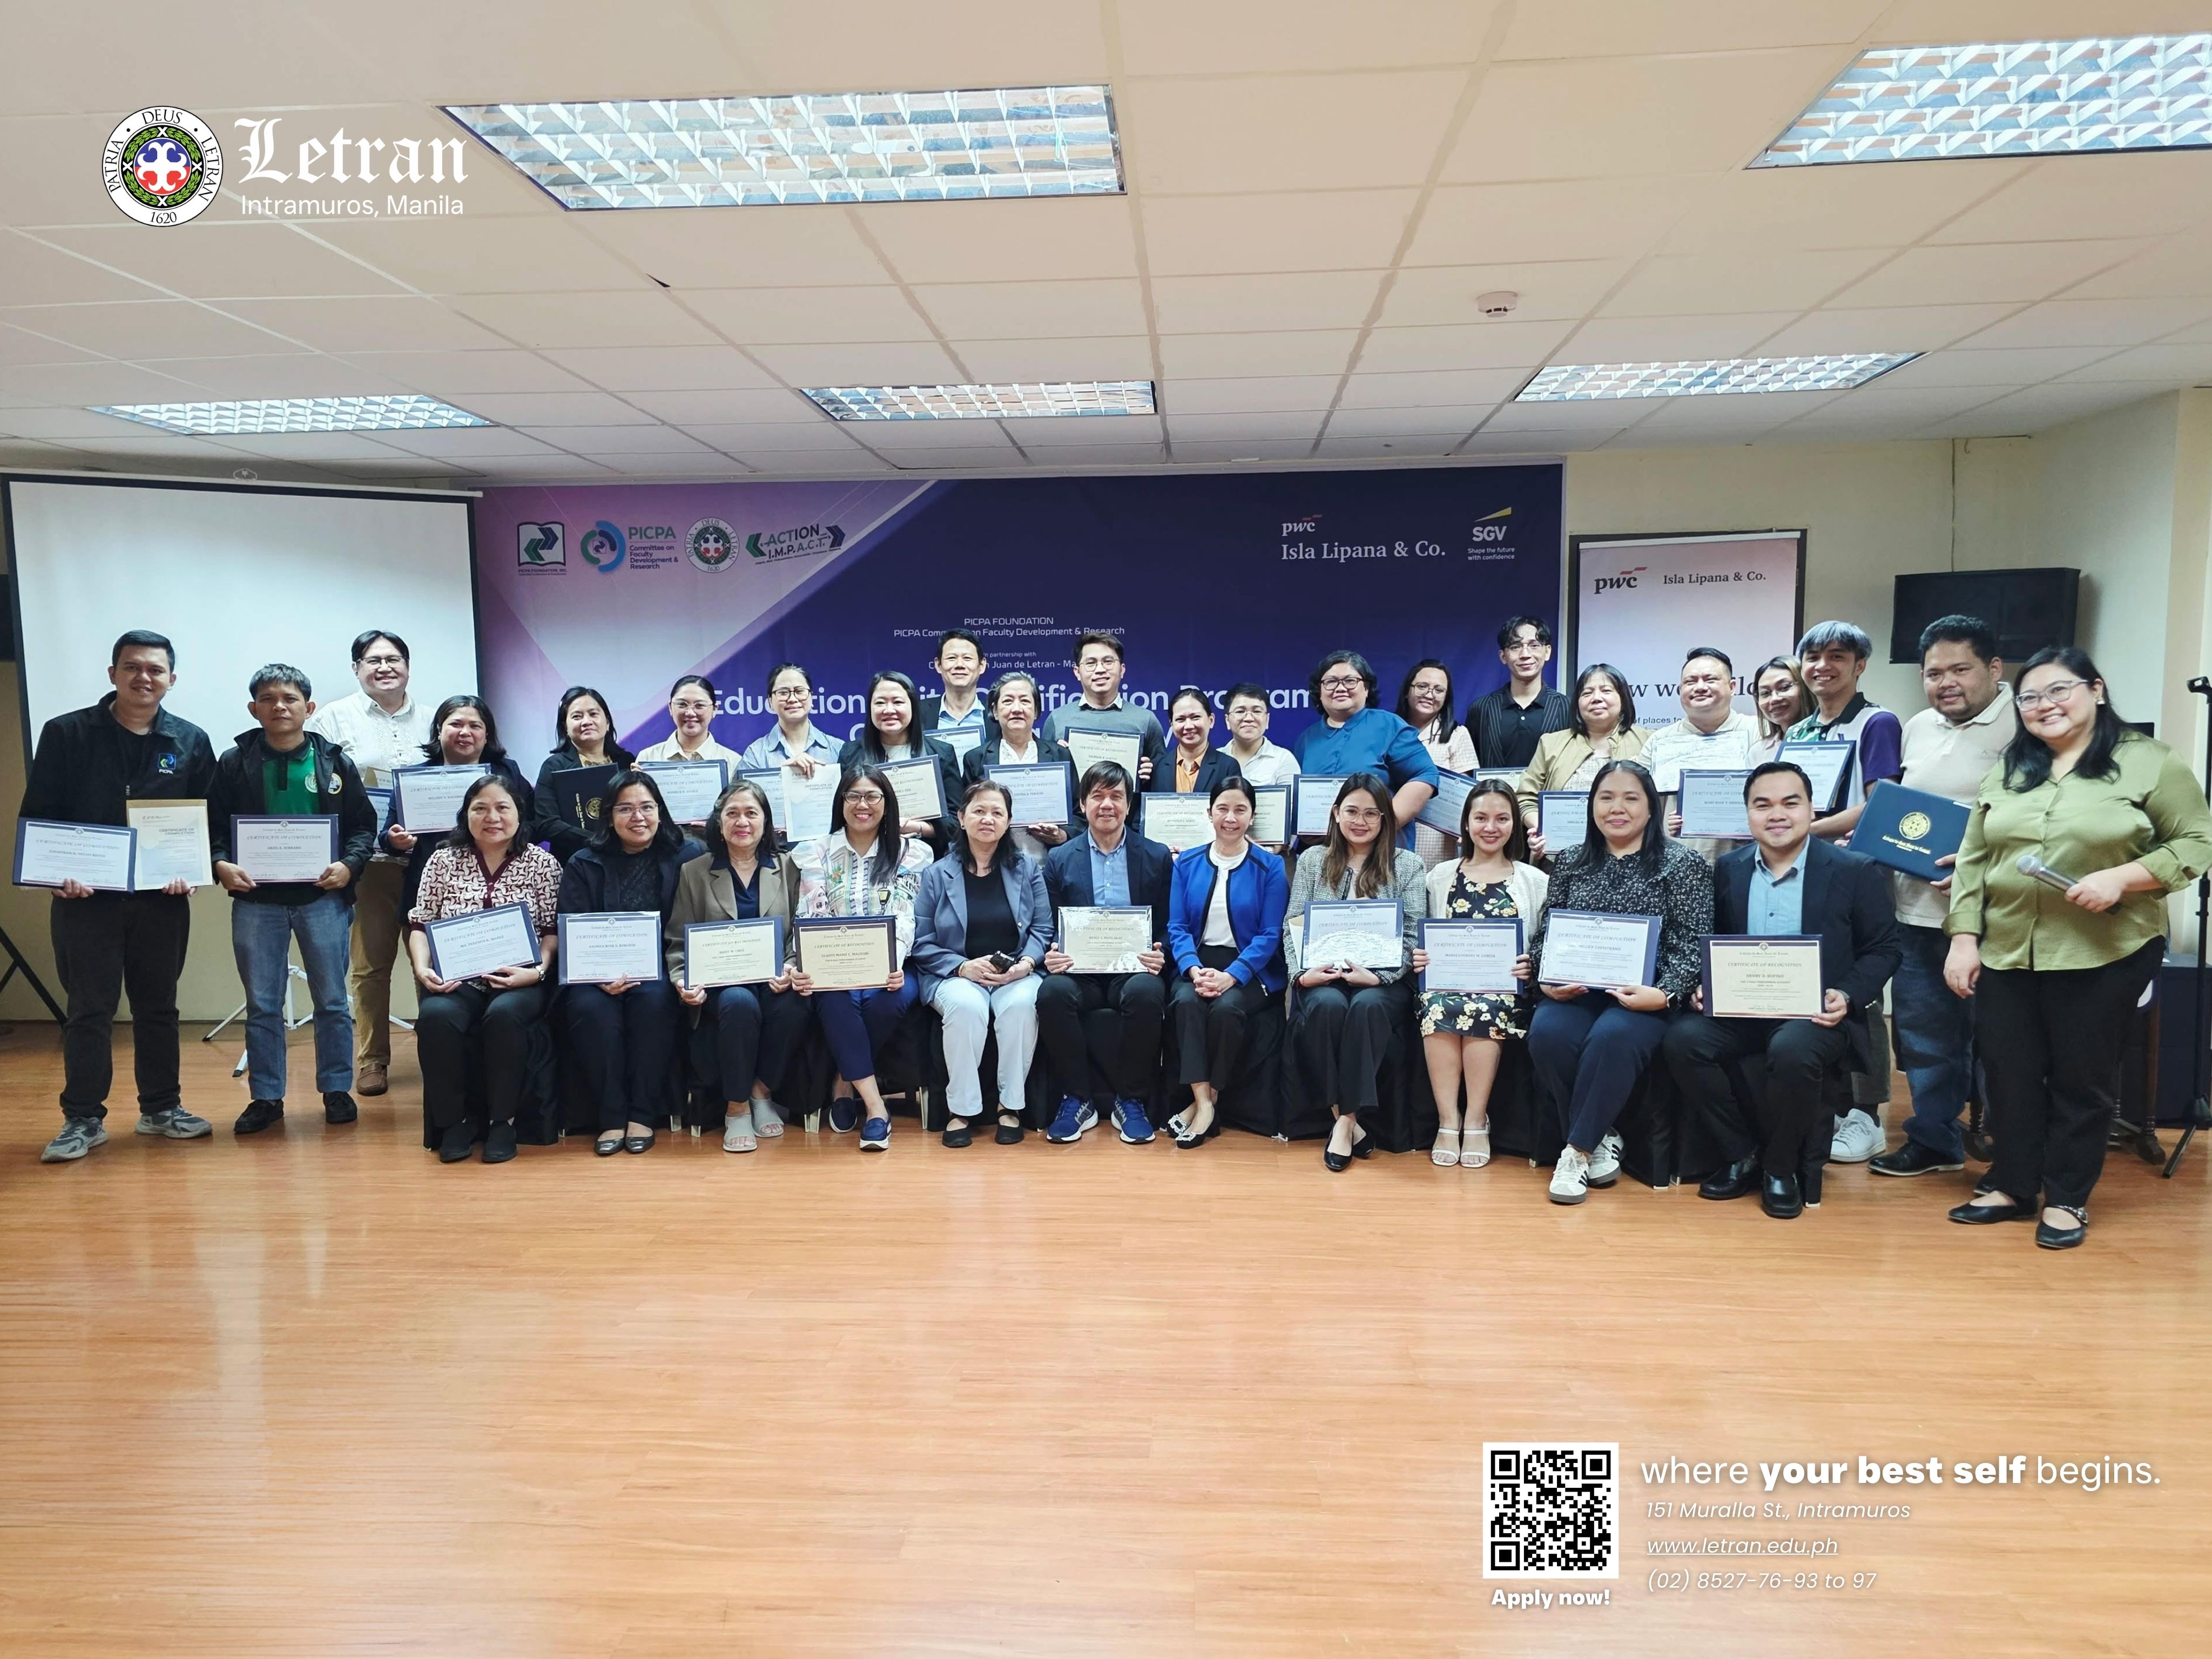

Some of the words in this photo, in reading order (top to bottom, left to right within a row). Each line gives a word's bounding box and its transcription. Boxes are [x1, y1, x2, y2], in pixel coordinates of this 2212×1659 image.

[629, 526, 676, 539] PICPA
[767, 523, 820, 547] ACTION
[1282, 522, 1316, 536] pwc
[1472, 526, 1507, 542] SGV
[1282, 543, 1316, 559] Isla
[1322, 542, 1387, 563] Lipana
[1394, 541, 1409, 557] &
[1415, 541, 1446, 557] Co.
[1663, 574, 1684, 584] Isla
[1688, 573, 1729, 585] Lipana
[1734, 572, 1742, 581] &
[1746, 571, 1766, 581] Co.
[1594, 576, 1637, 595] pwc
[993, 617, 1054, 625] FOUNDATION
[894, 629, 921, 637] PICPA
[983, 629, 1015, 637] Faculty
[1016, 628, 1073, 637] Development
[992, 660, 1012, 669] Juan
[1014, 660, 1025, 669] de
[1027, 660, 1055, 669] Letran
[1643, 717, 1671, 726] places
